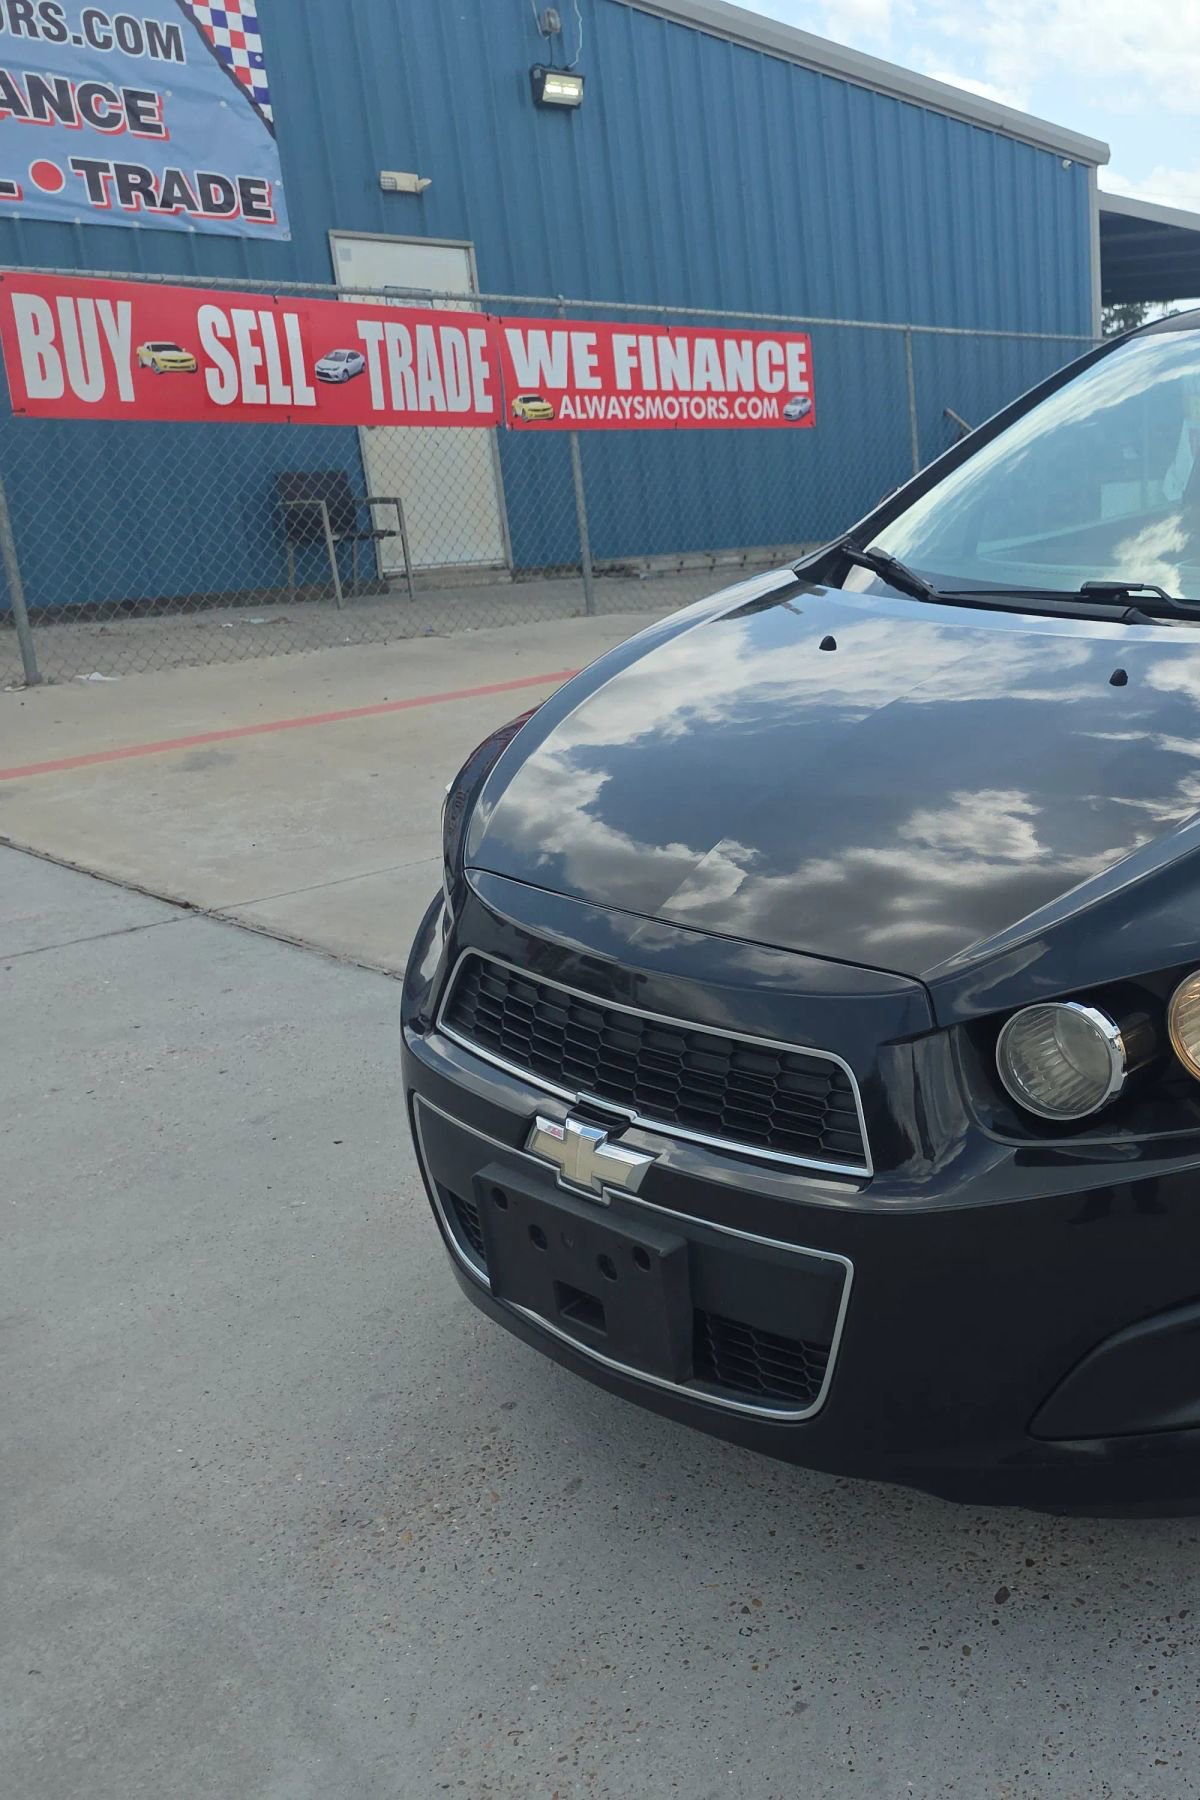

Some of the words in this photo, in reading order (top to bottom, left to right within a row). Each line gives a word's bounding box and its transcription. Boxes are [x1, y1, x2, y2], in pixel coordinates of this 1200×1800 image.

[0, 0, 186, 64] RS.COM
[69, 157, 277, 223] TRADE
[11, 292, 135, 403] BUY
[197, 304, 316, 406] SELL
[357, 320, 493, 413] TRADE
[504, 328, 602, 390] WE
[612, 333, 809, 393] FINANCE
[559, 394, 779, 420] ALWAYSMOTORS.COM
